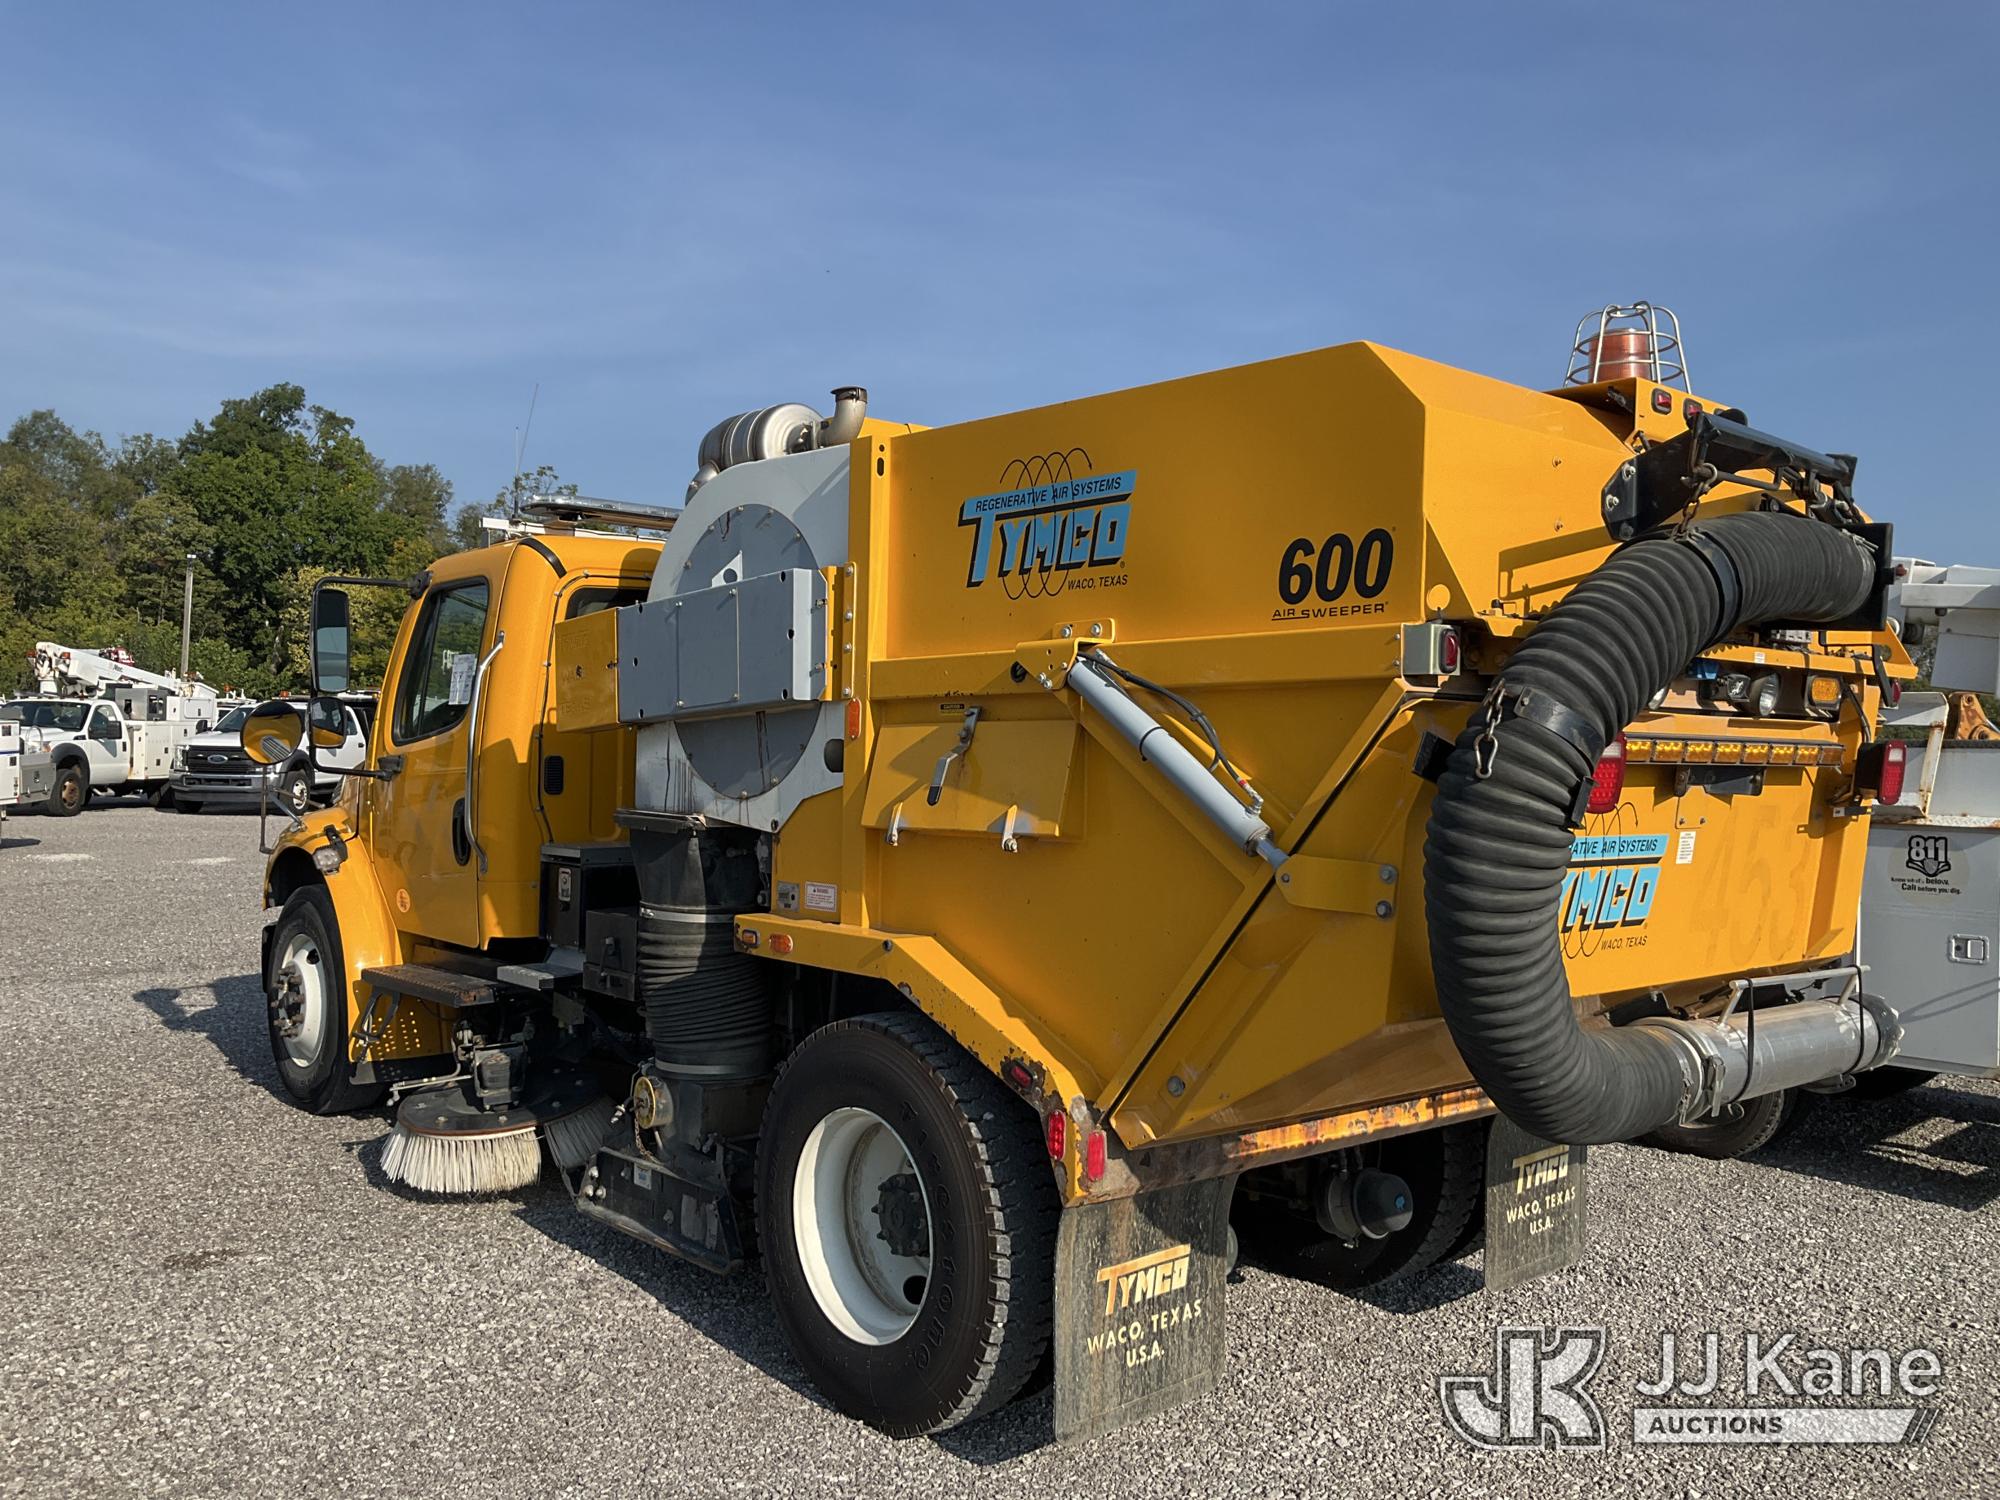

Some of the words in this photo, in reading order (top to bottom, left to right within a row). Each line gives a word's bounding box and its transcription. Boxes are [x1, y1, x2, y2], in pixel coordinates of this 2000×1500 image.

[975, 490, 1047, 512] REGENERATIVE
[1052, 486, 1068, 500] AIR
[1072, 477, 1122, 497] SYSTEMS
[958, 470, 1137, 588] TYMCO
[1067, 578, 1096, 590] WACO,
[1099, 574, 1128, 588] TEXAS
[1278, 528, 1394, 605] 600
[1272, 608, 1296, 618] AIR
[1301, 603, 1384, 618] SWEEPER
[1601, 840, 1616, 854] AIR
[1619, 839, 1658, 853] SYSTEMS
[1908, 835, 1947, 862] 811
[1558, 850, 1664, 933] MCO
[1625, 935, 1648, 948] TEXAS
[1512, 1144, 1570, 1195] TYMCO
[1507, 1200, 1542, 1224] WACO,
[1545, 1186, 1576, 1209] TEXAS
[1530, 1216, 1554, 1235] U.S.A.
[1097, 1243, 1191, 1316] TYMCO
[1087, 1321, 1144, 1355] WACO,
[1151, 1299, 1201, 1332] TEXAS
[1126, 1340, 1164, 1367] U.S.A.
